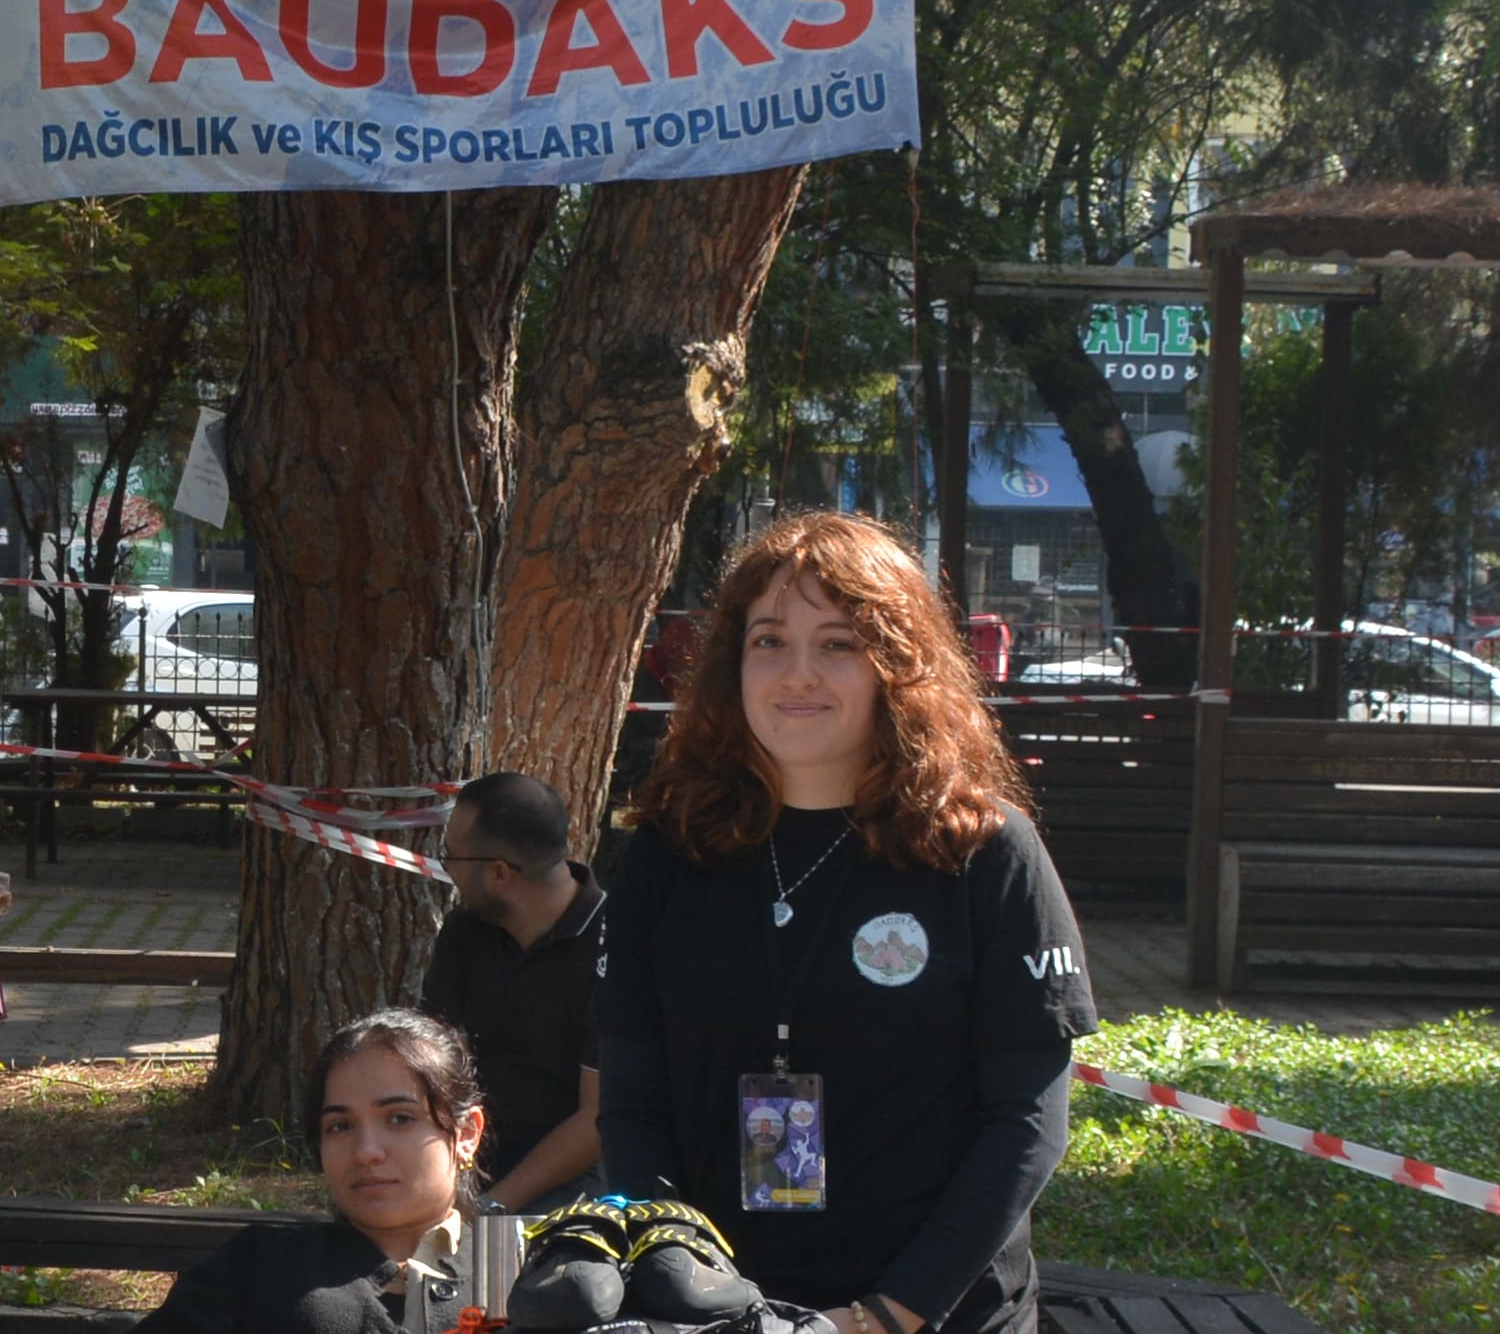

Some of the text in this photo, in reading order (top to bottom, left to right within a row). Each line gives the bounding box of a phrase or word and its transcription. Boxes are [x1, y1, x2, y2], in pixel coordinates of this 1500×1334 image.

[41, 70, 887, 166] DAĞCILIK ve KIŞ SPORLARI TOPLULUĞU
[1104, 362, 1175, 380] FOOD
